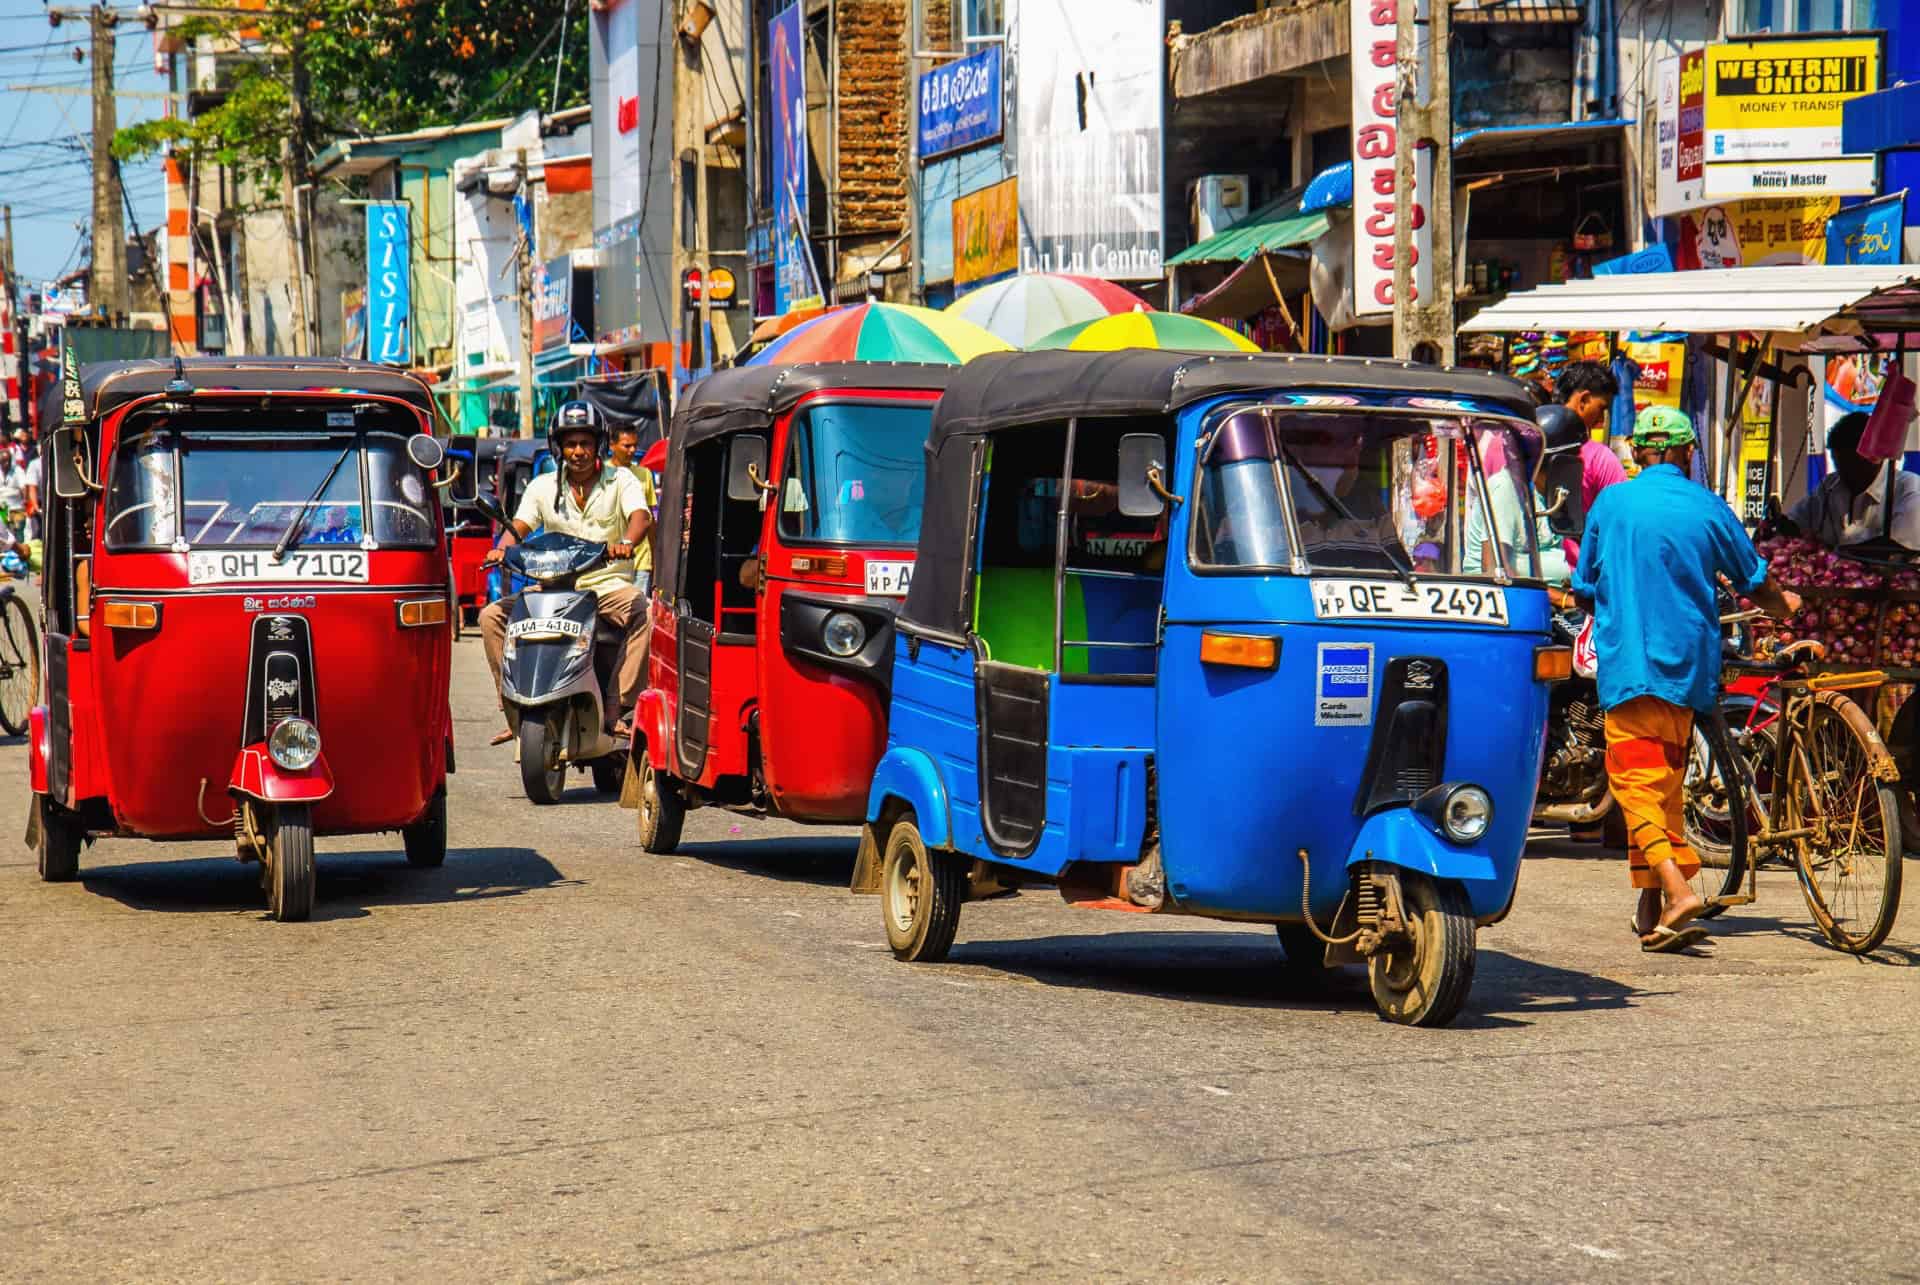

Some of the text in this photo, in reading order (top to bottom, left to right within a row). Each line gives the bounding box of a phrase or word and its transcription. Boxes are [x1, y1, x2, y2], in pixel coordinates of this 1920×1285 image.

[1718, 58, 1841, 79] WESTERN
[1756, 75, 1841, 94] UNION
[1740, 102, 1786, 113] MONEY
[1753, 173, 1828, 188] Money Master
[1056, 244, 1087, 273] Lu
[1090, 242, 1160, 272] Centre
[379, 212, 402, 358] SISIL
[221, 554, 258, 577] QH
[292, 554, 365, 578] 7102
[1349, 584, 1393, 613] QE
[1426, 587, 1505, 620] 2491
[1322, 665, 1366, 674] AMERICAN
[1331, 675, 1368, 684] EXPRESS
[1320, 702, 1347, 711] Cards
[1320, 711, 1363, 720] Welcome
